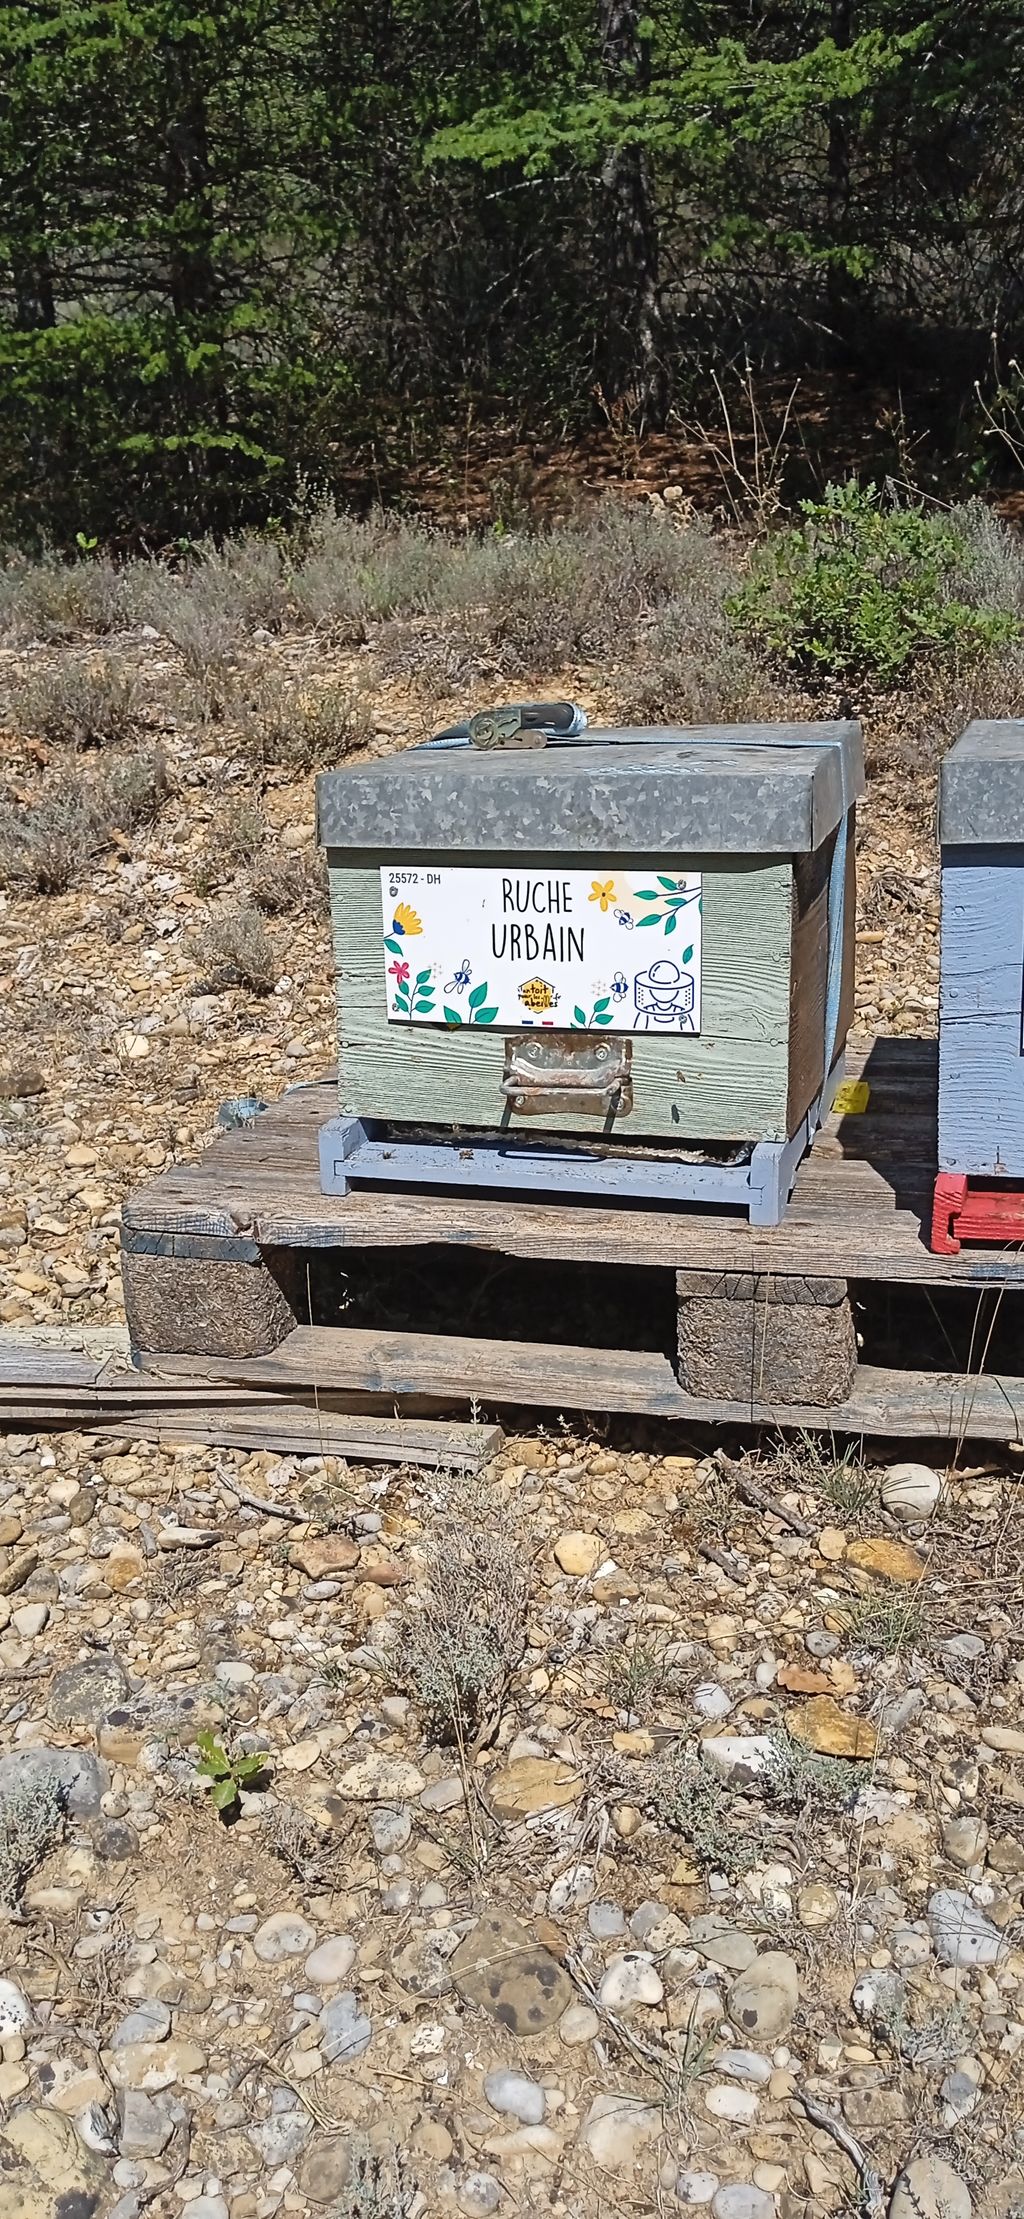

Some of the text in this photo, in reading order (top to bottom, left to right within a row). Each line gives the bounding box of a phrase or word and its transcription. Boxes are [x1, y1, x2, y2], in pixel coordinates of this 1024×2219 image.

[389, 873, 419, 885] 25572
[426, 873, 441, 885] DH
[502, 877, 573, 914] RUCHE
[491, 923, 585, 963] URBAIN
[530, 984, 549, 994] toit
[524, 995, 558, 1008] abeilles
